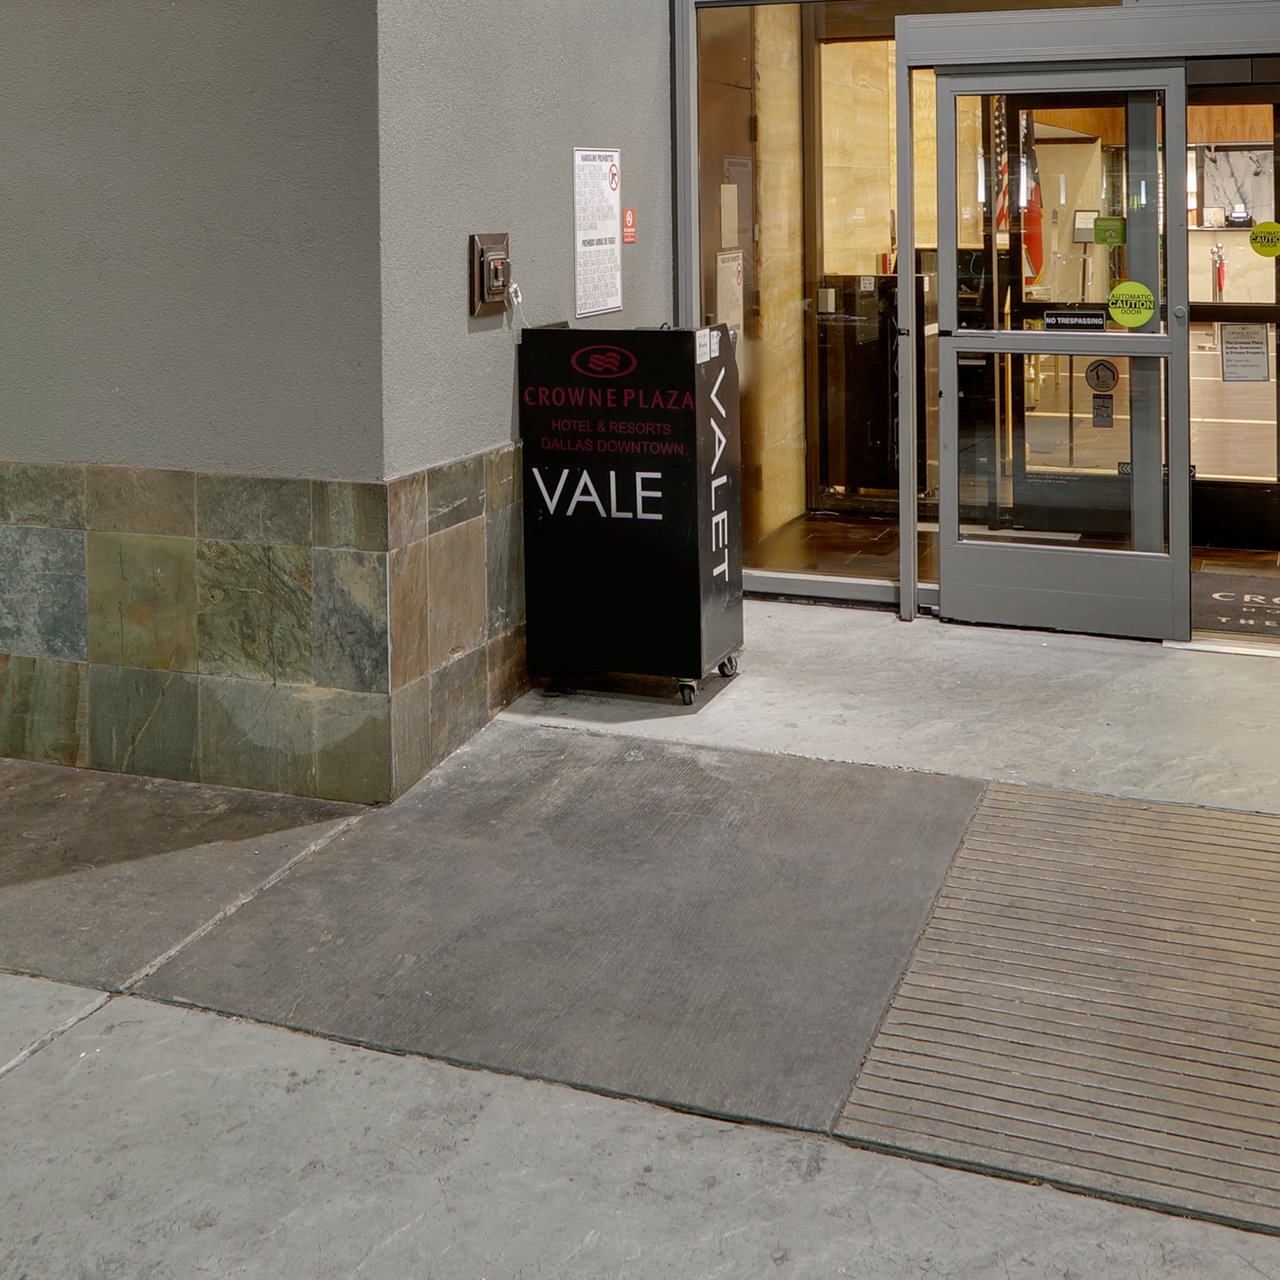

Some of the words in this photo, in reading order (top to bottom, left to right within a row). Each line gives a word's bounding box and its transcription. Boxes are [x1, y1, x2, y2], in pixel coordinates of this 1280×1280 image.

[1108, 300, 1154, 309] CAUTION
[1056, 317, 1103, 325] TRESPASSING
[523, 387, 617, 408] CROWNE
[623, 388, 696, 410] PLAZA
[552, 419, 594, 433] HOTEL
[597, 421, 606, 433] &
[609, 421, 672, 436] RESORTS
[541, 437, 593, 452] DALLAS
[597, 439, 684, 455] DOWNTOWN
[710, 366, 729, 582] VALET
[531, 467, 663, 520] VALE
[1217, 616, 1278, 627] THE
